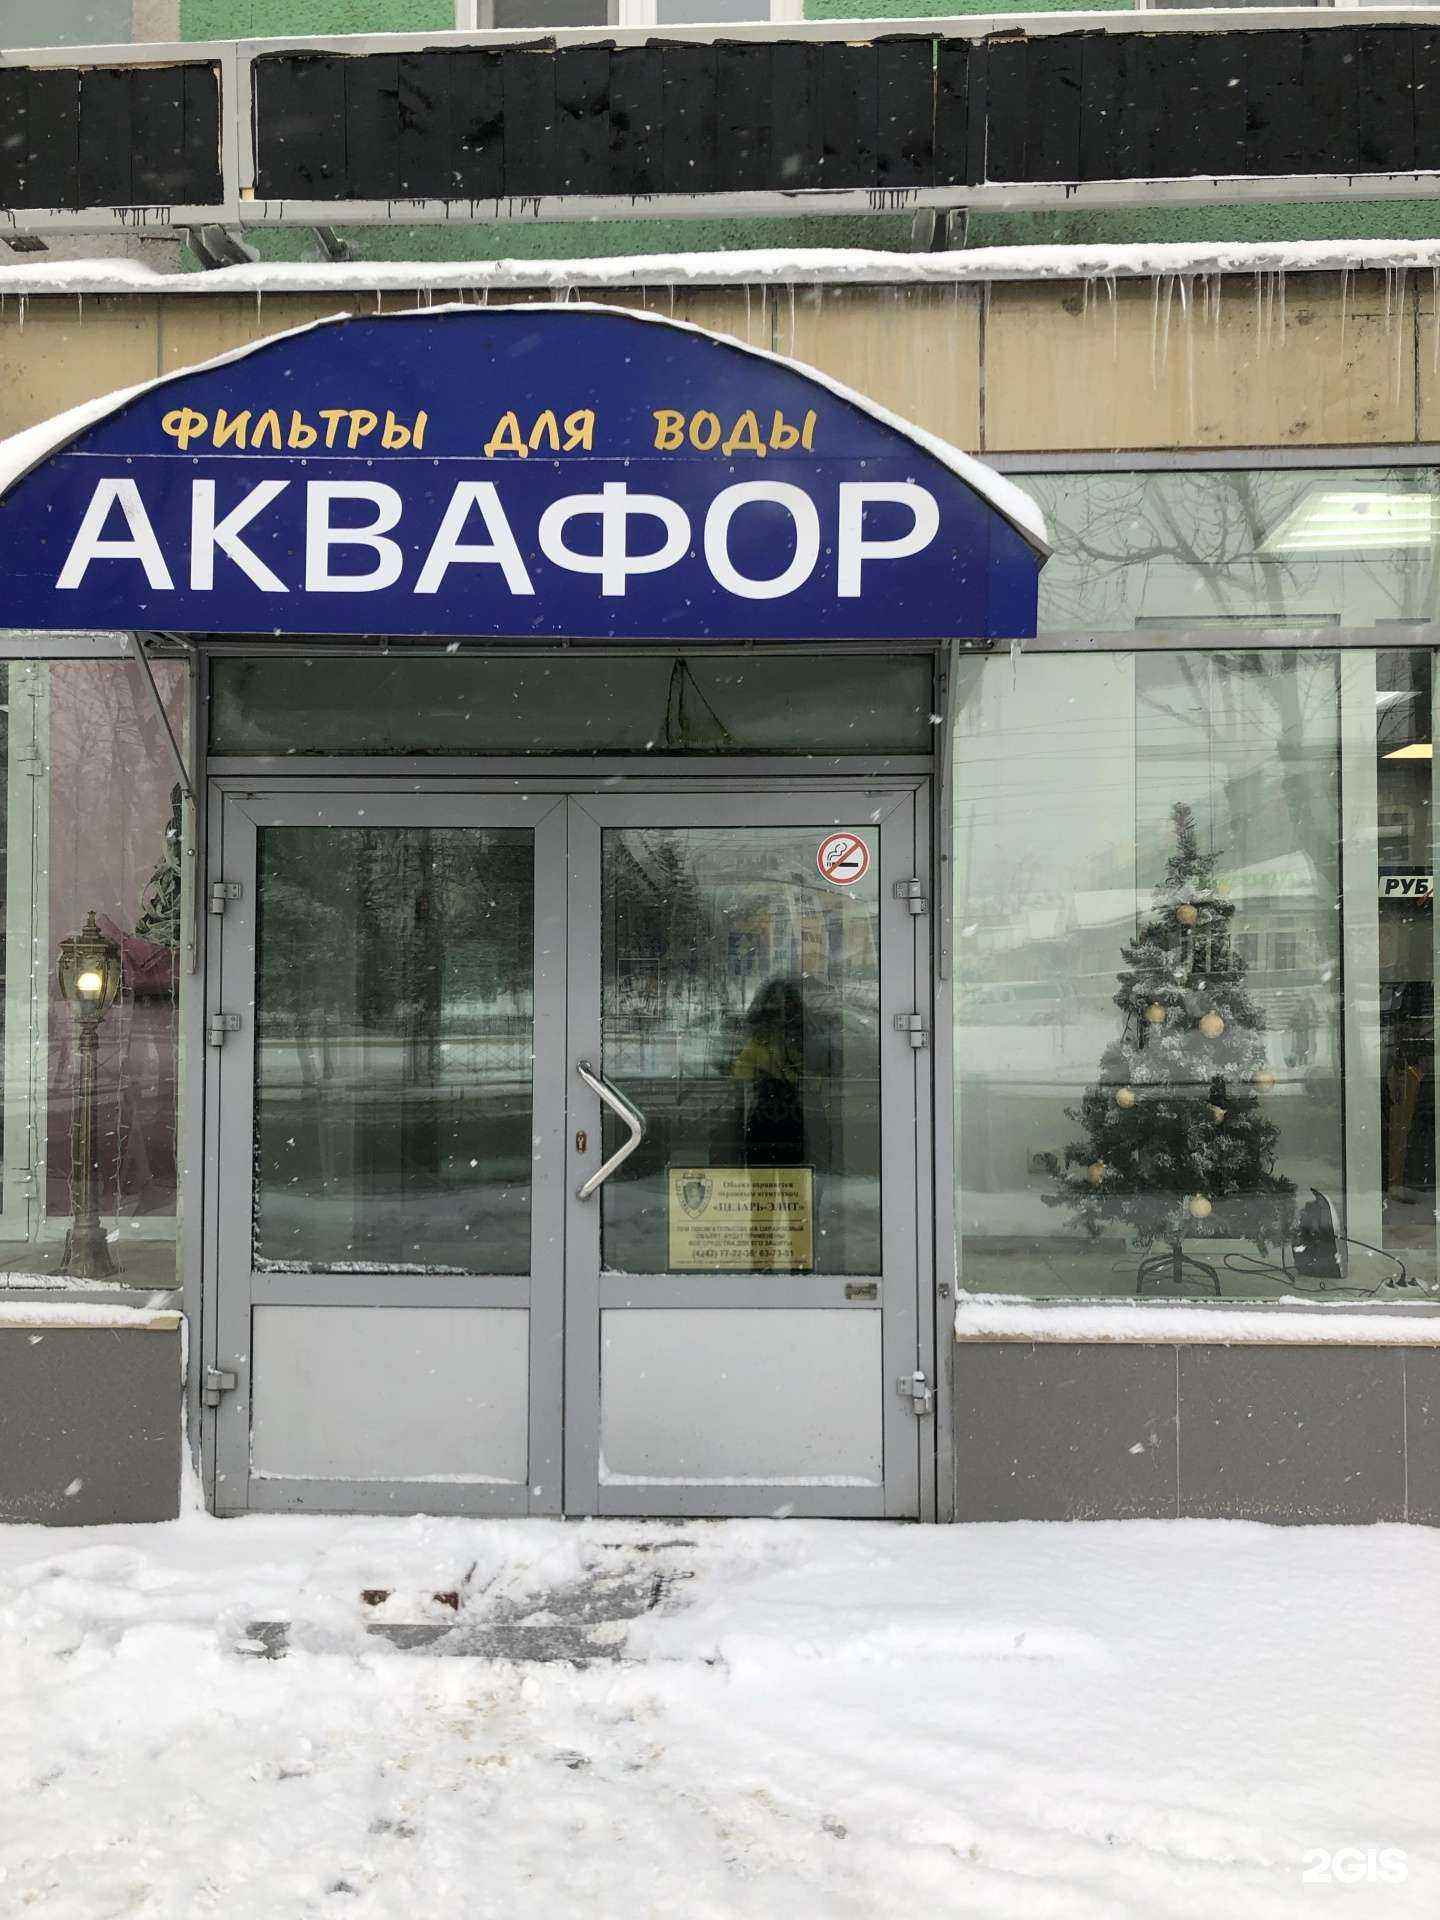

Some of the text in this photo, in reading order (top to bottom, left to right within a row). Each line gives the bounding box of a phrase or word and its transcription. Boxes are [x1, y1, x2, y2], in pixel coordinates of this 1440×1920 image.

[161, 407, 817, 458] ФИЛЬТРЫ ДЛЯ ВОДЫ
[55, 478, 940, 600] АКВАФОР
